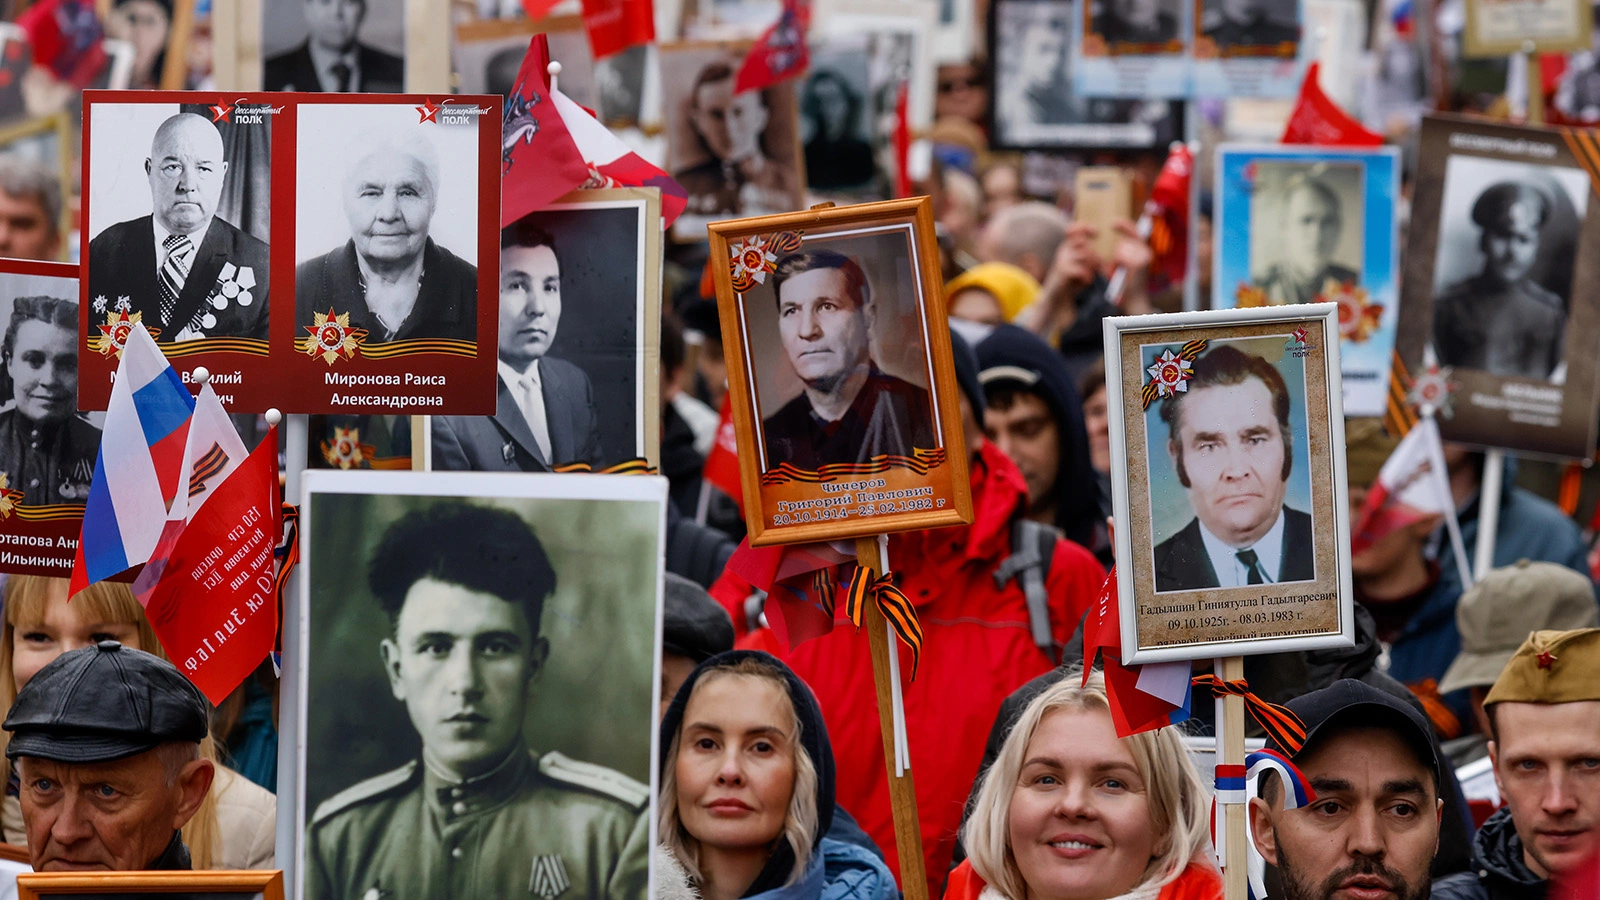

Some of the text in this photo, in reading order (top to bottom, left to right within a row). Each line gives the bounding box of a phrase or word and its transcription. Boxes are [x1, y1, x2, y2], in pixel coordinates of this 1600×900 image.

[235, 115, 263, 124] ПОЛК
[442, 116, 470, 125] ПОЛК
[181, 371, 242, 384] Ваилий
[324, 372, 446, 388] Миронова Раиса
[330, 393, 443, 408] Александровна
[821, 478, 886, 493] Чичеров
[778, 486, 933, 512] Григорий Павлович
[937, 498, 946, 507] г
[1140, 592, 1338, 616] Гадылшин Гиниятулла Гадылгареевич
[1168, 616, 1230, 631] 09.10.1925г.
[1239, 611, 1294, 625] 08.03.1983
[1296, 613, 1304, 621] г.
